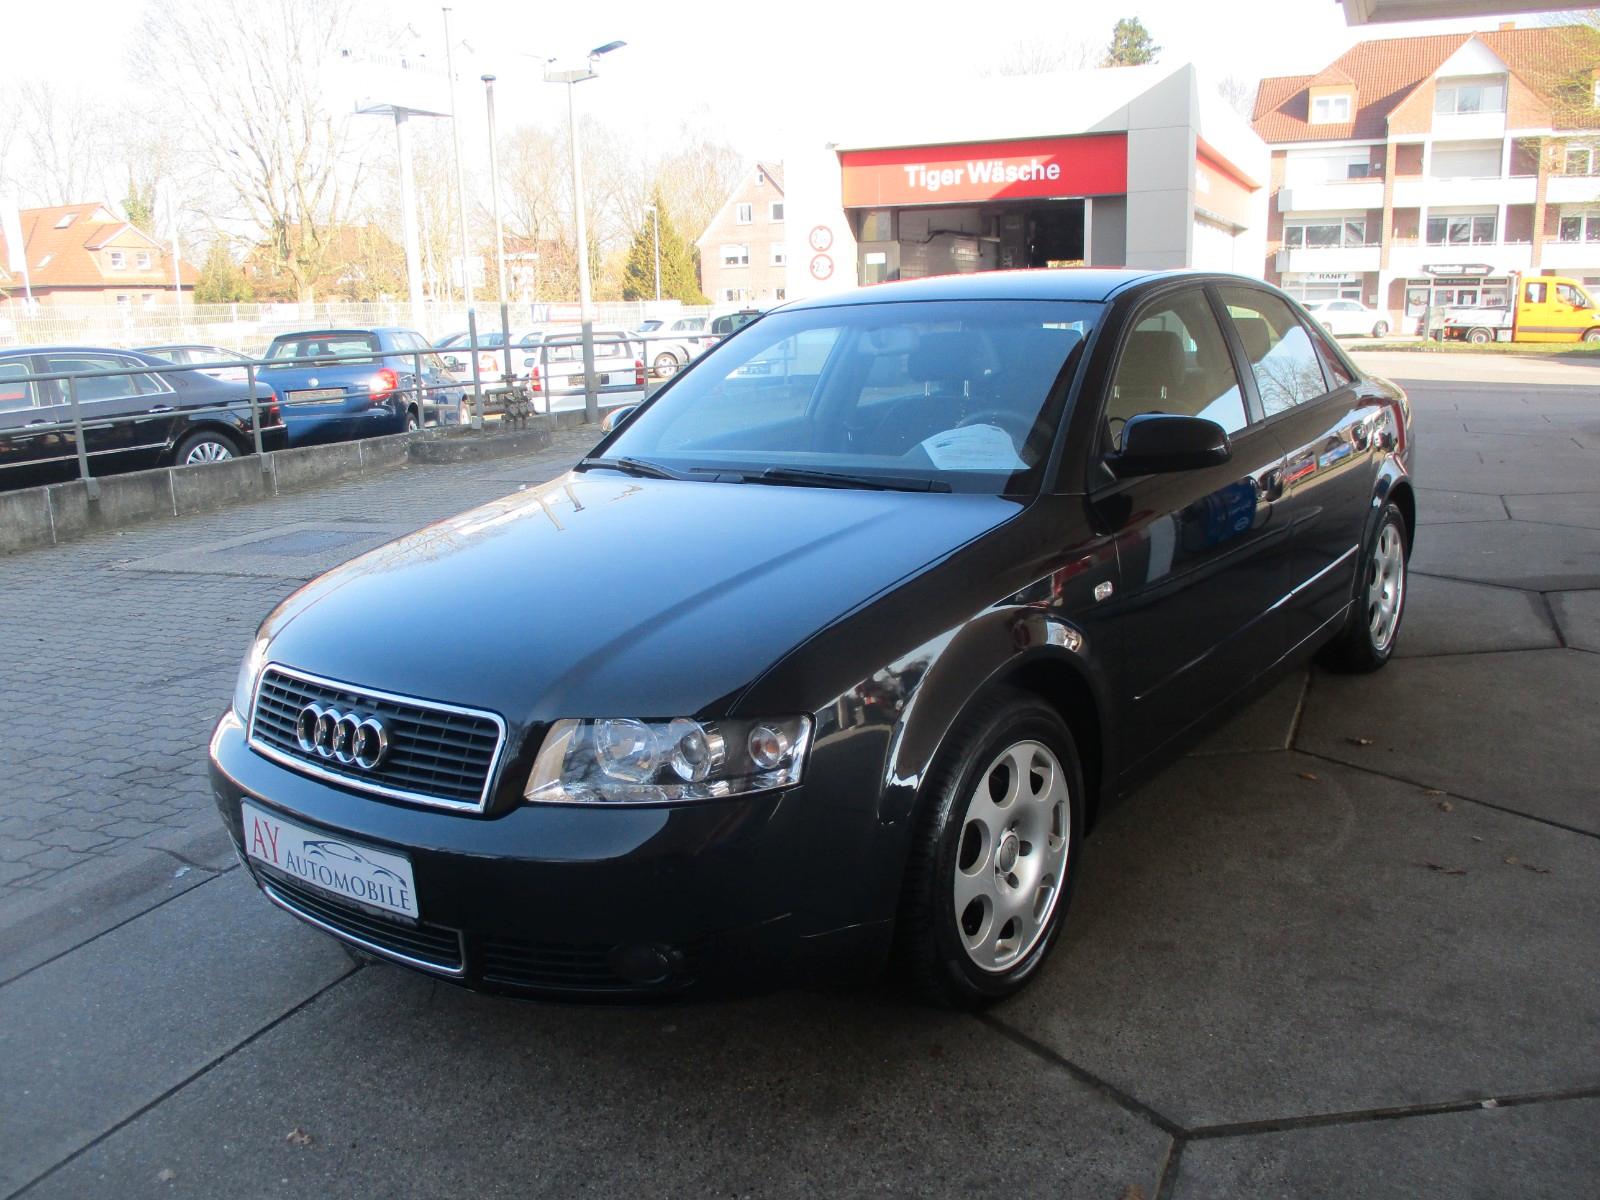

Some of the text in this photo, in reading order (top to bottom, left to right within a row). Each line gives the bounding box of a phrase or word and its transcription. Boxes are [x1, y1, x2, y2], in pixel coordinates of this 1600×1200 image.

[904, 159, 1061, 191] Tiger Wäsche
[252, 815, 280, 864] AY
[286, 849, 411, 910] AUTOMOBILE
